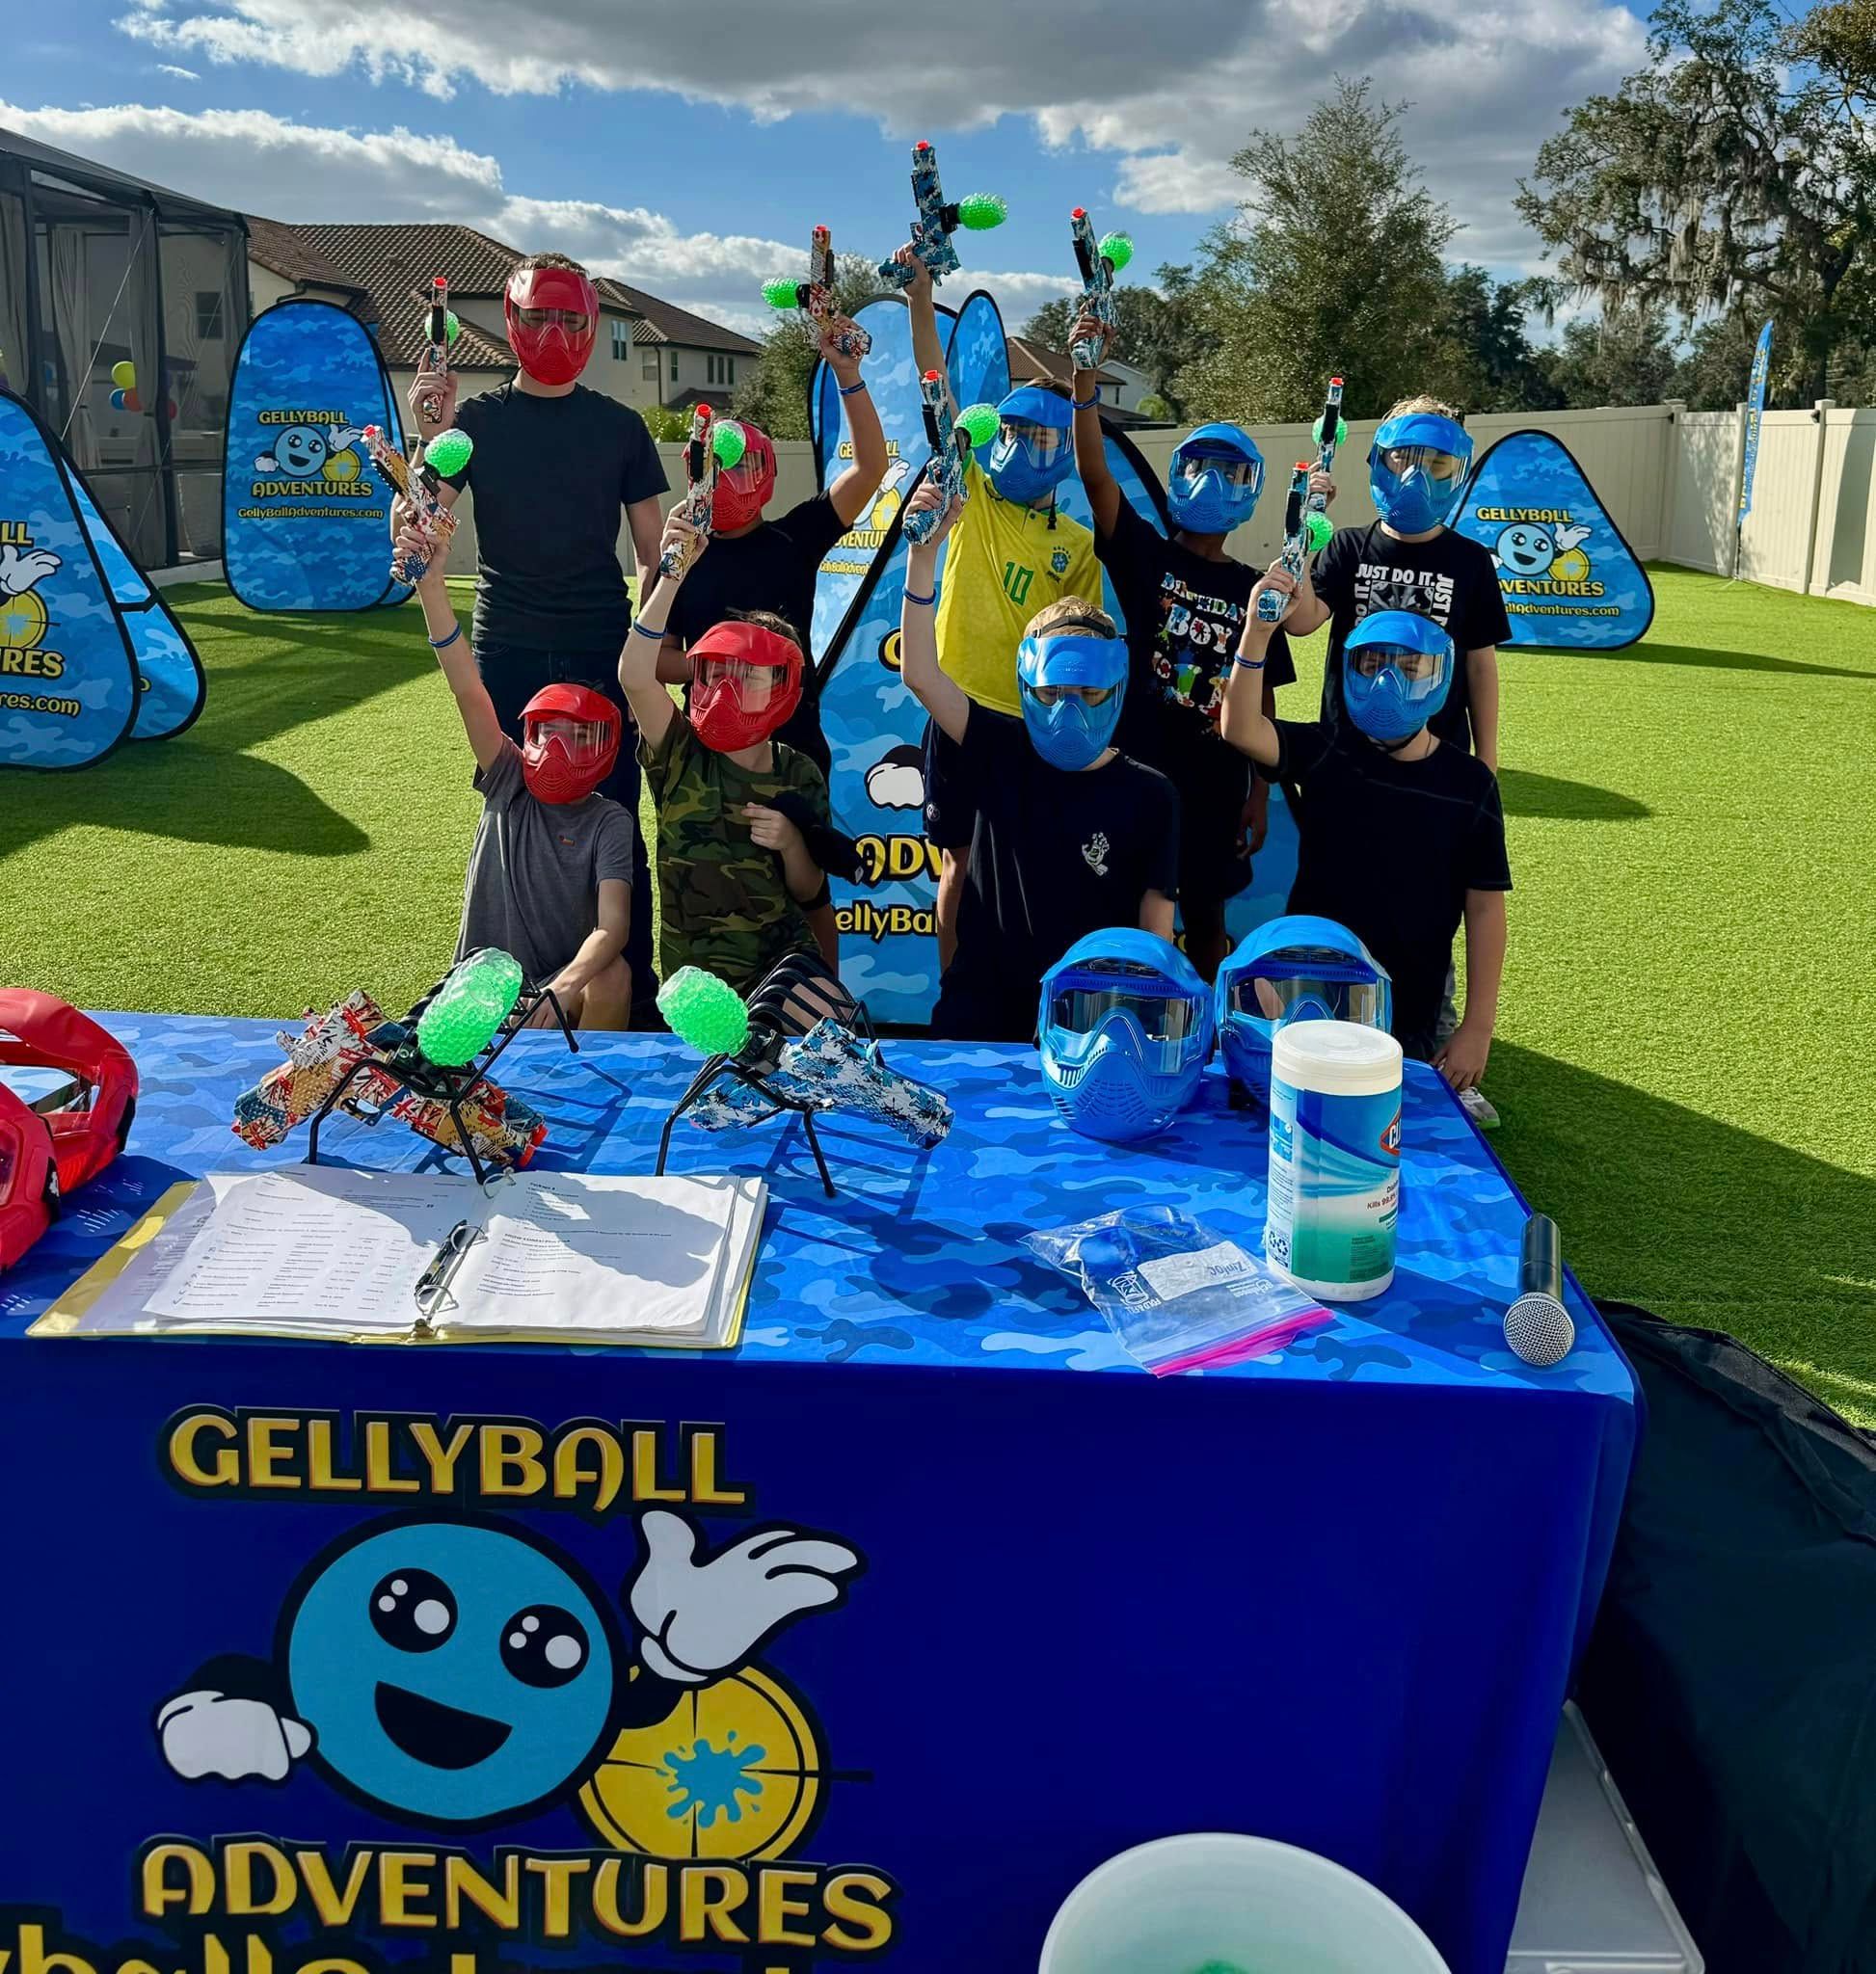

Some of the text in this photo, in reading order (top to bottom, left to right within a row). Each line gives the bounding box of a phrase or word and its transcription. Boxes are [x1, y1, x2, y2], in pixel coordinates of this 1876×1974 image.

[258, 411, 349, 424] GELLYBALL
[253, 481, 372, 497] ADVENTURES
[238, 507, 384, 519] GellyBallAdventures.com
[1476, 506, 1573, 523] GELLYBALL
[1004, 562, 1033, 605] 10
[1355, 564, 1435, 586] JUST DO IT.
[1499, 578, 1605, 596] VENTURES
[1433, 574, 1454, 613] JUST
[1166, 603, 1233, 654] BOY
[0, 648, 64, 678] RES
[171, 1413, 746, 1512] GELLYBALL
[142, 1842, 894, 1953] ADVENTURES
